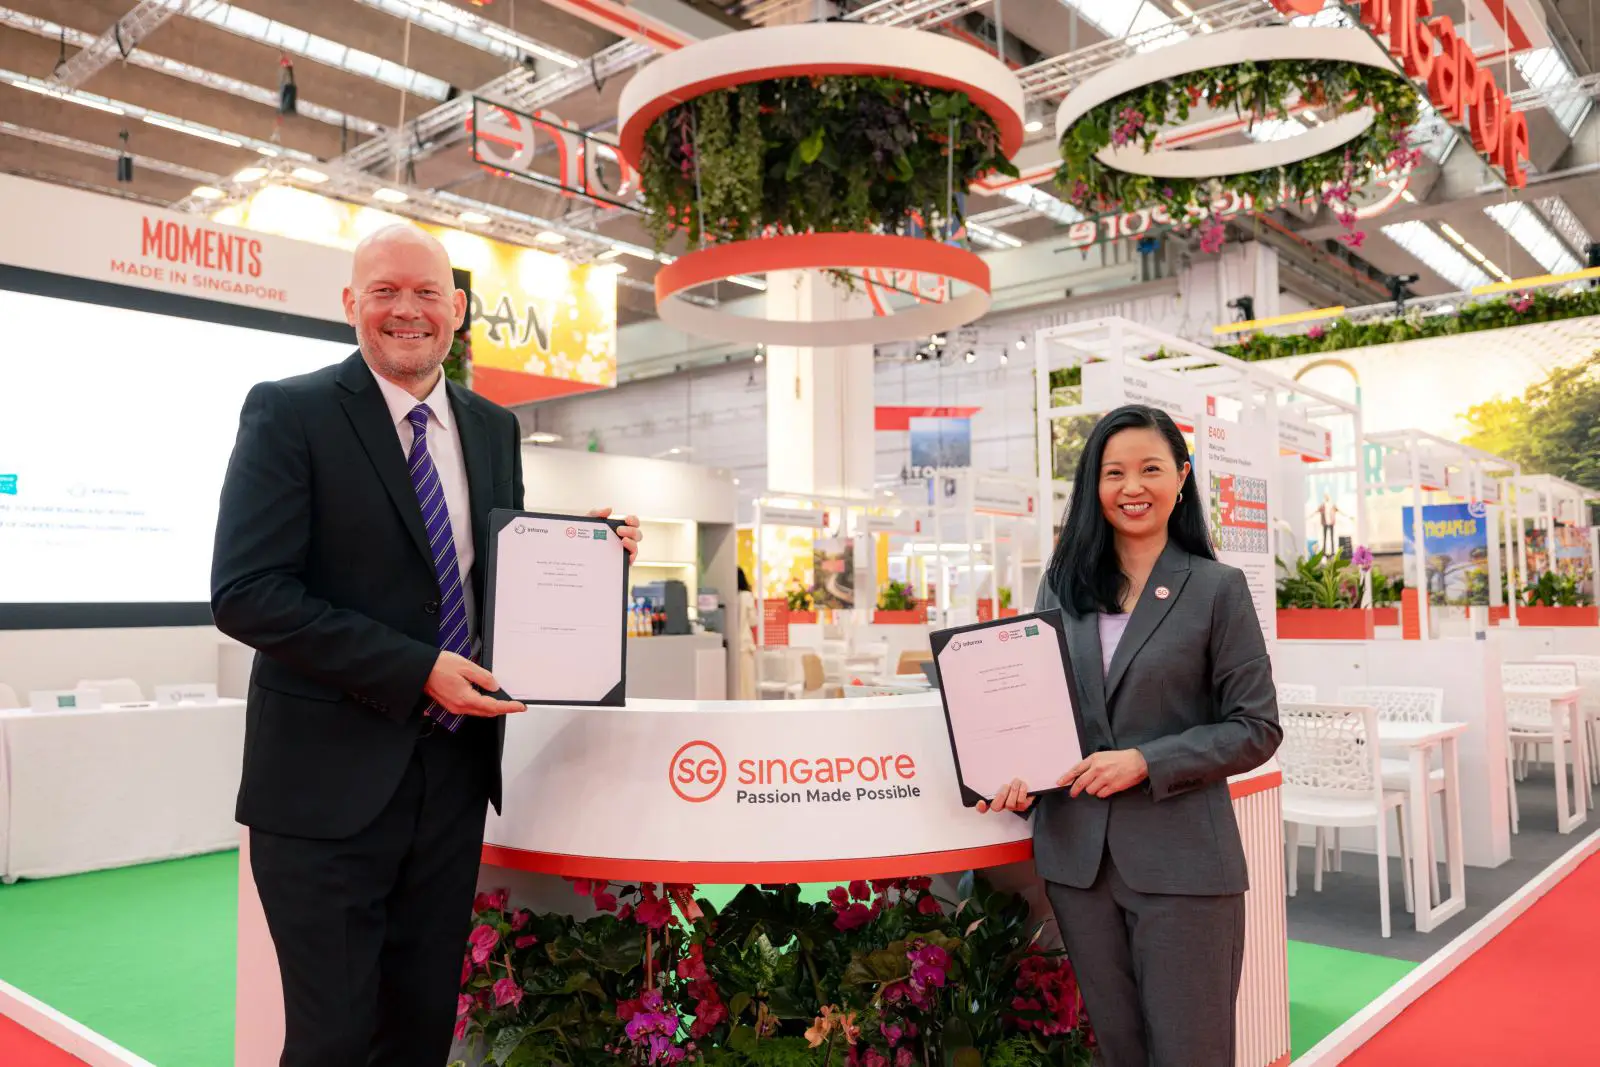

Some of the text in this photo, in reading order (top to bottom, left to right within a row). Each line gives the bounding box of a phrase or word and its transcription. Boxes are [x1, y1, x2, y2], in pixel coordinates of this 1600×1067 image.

[142, 216, 262, 278] MOMENTS
[110, 259, 288, 302] MADE IN SINGAPORE
[1208, 426, 1226, 440] E400
[963, 639, 983, 647] informa
[677, 758, 719, 784] SG
[736, 784, 921, 803] Passion Made Possible
